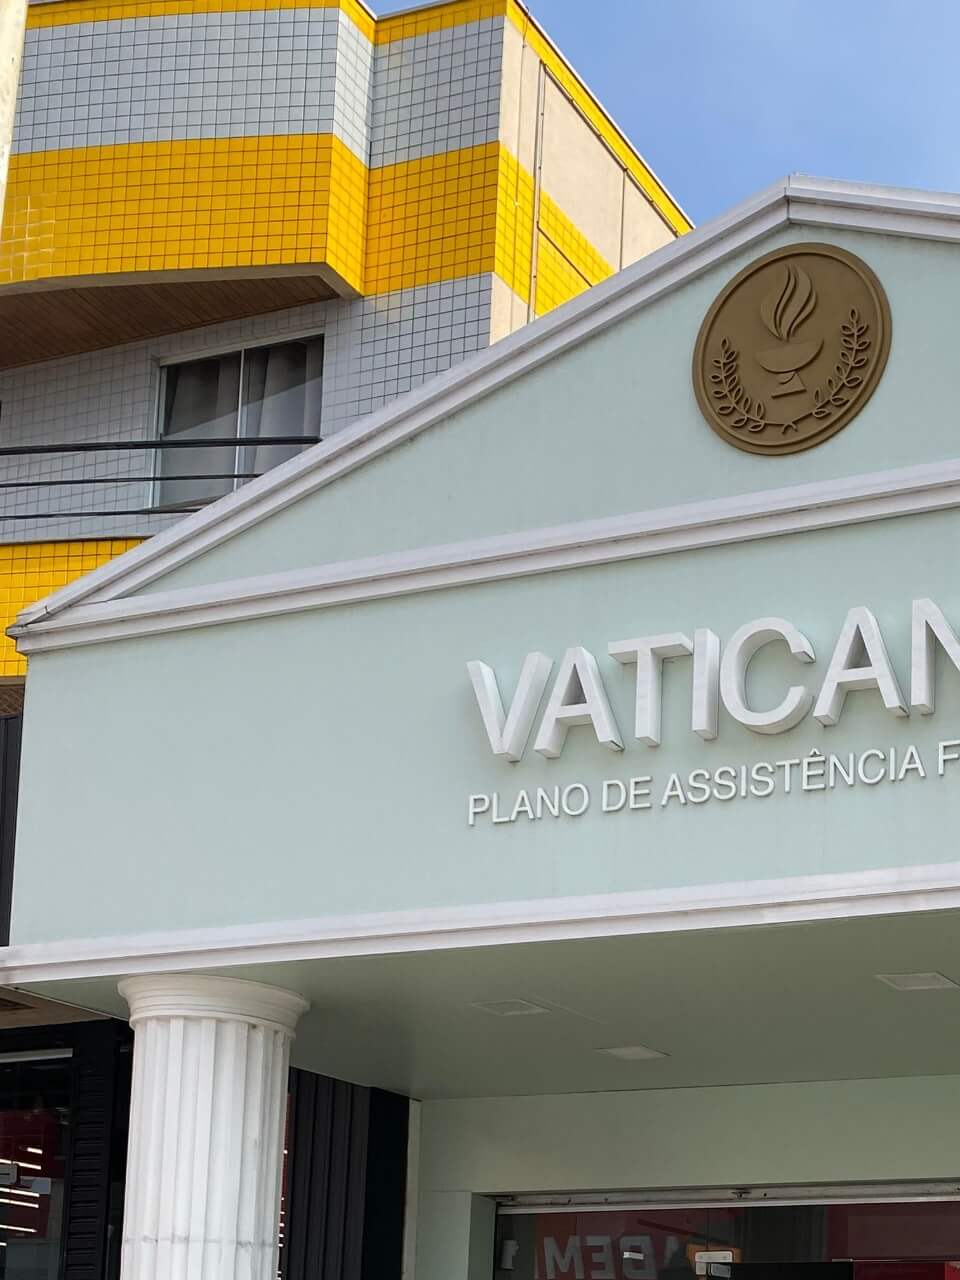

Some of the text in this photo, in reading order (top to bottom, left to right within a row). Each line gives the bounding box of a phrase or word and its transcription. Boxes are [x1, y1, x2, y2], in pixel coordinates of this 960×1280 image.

[468, 783, 590, 826] PLANO
[601, 776, 653, 813] DE
[661, 745, 924, 806] ASSISTÊNCIA
